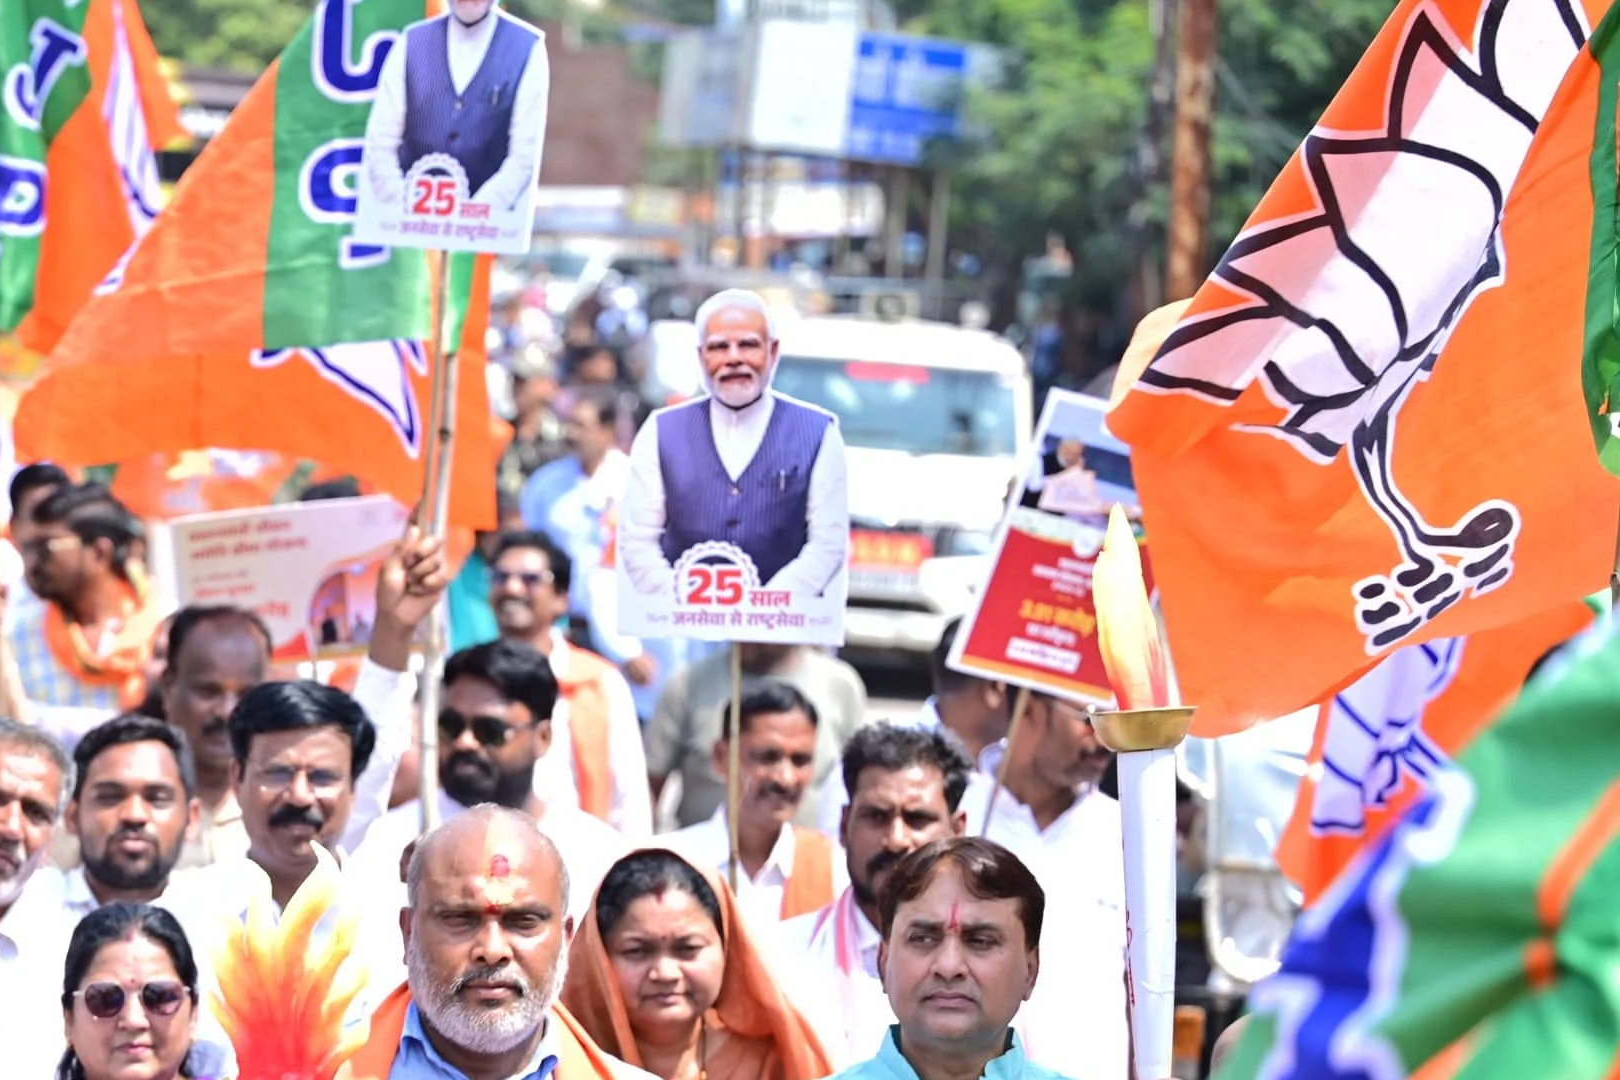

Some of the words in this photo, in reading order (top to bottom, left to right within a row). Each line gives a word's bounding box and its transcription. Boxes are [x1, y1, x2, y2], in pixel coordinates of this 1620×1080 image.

[412, 178, 456, 216] 25
[687, 568, 744, 606] 25
[749, 590, 791, 607] साल
[672, 609, 726, 627] जनसेवा
